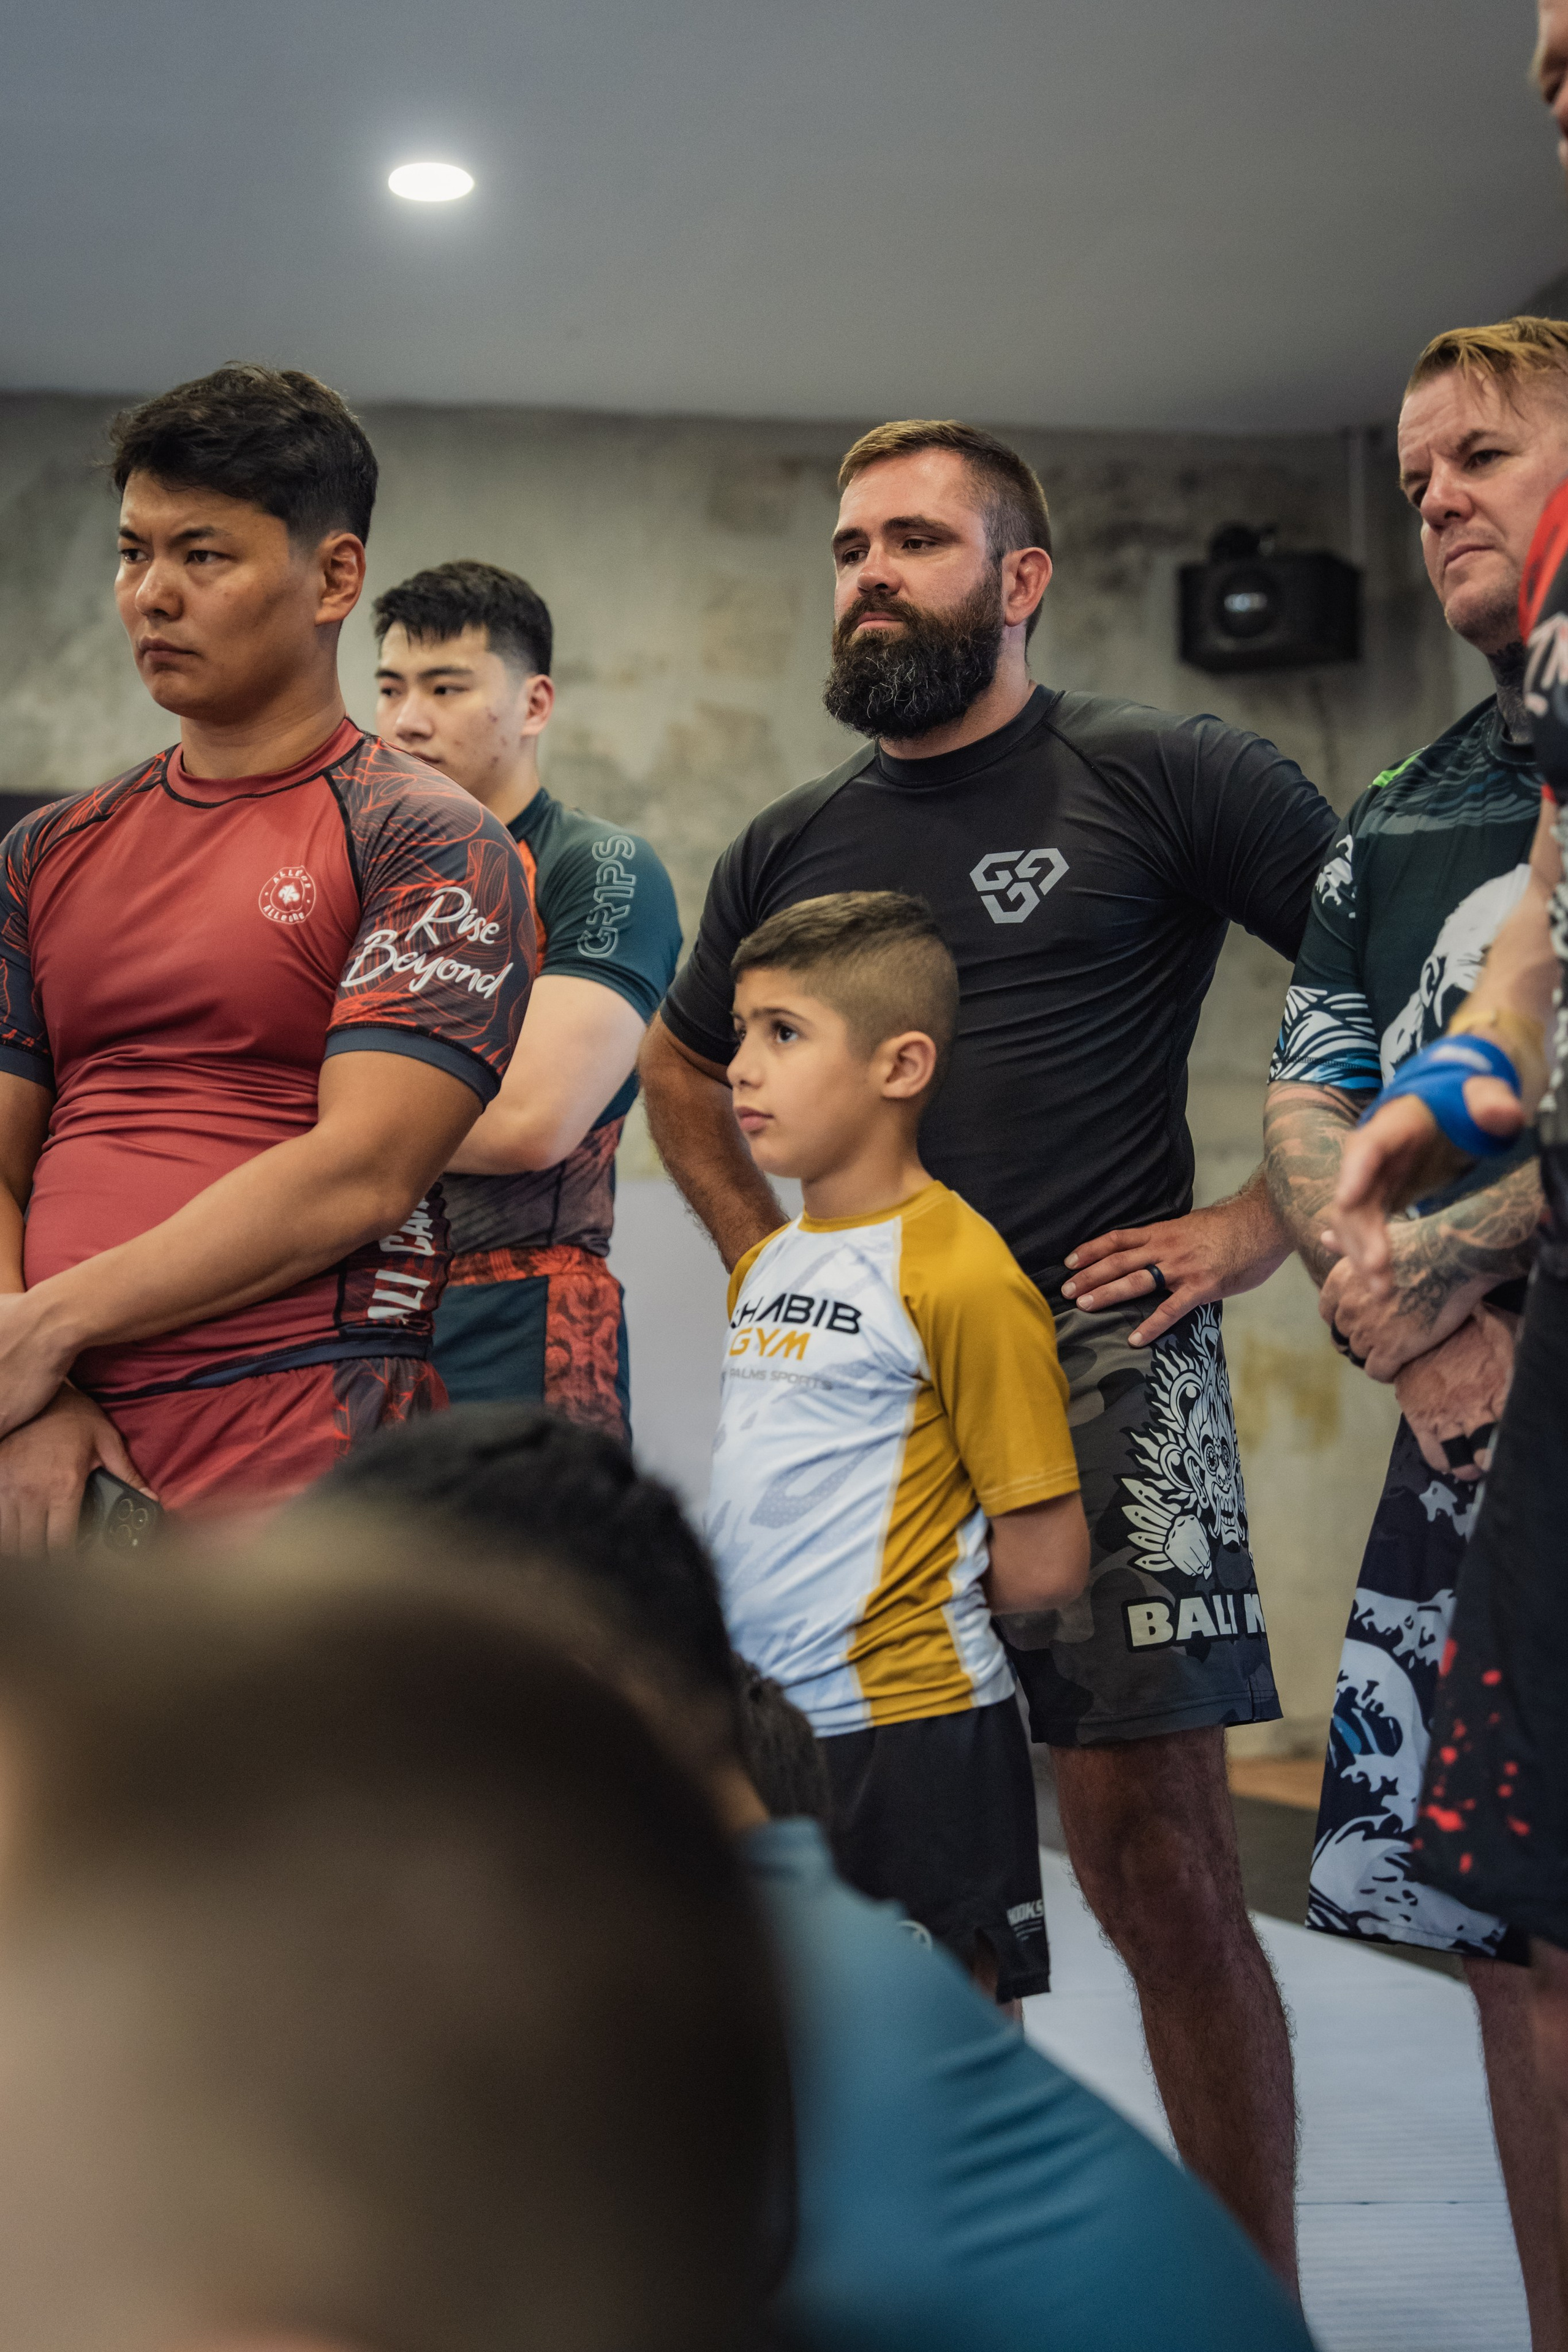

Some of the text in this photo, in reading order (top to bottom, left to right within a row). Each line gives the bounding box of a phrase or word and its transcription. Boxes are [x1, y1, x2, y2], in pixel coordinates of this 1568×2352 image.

[404, 887, 499, 945] Rise
[577, 835, 636, 958] GRIPS
[341, 929, 513, 999] Beyond
[730, 1292, 862, 1335] HABIB
[729, 1327, 811, 1361] GYM
[1127, 1594, 1238, 1647] BALI
